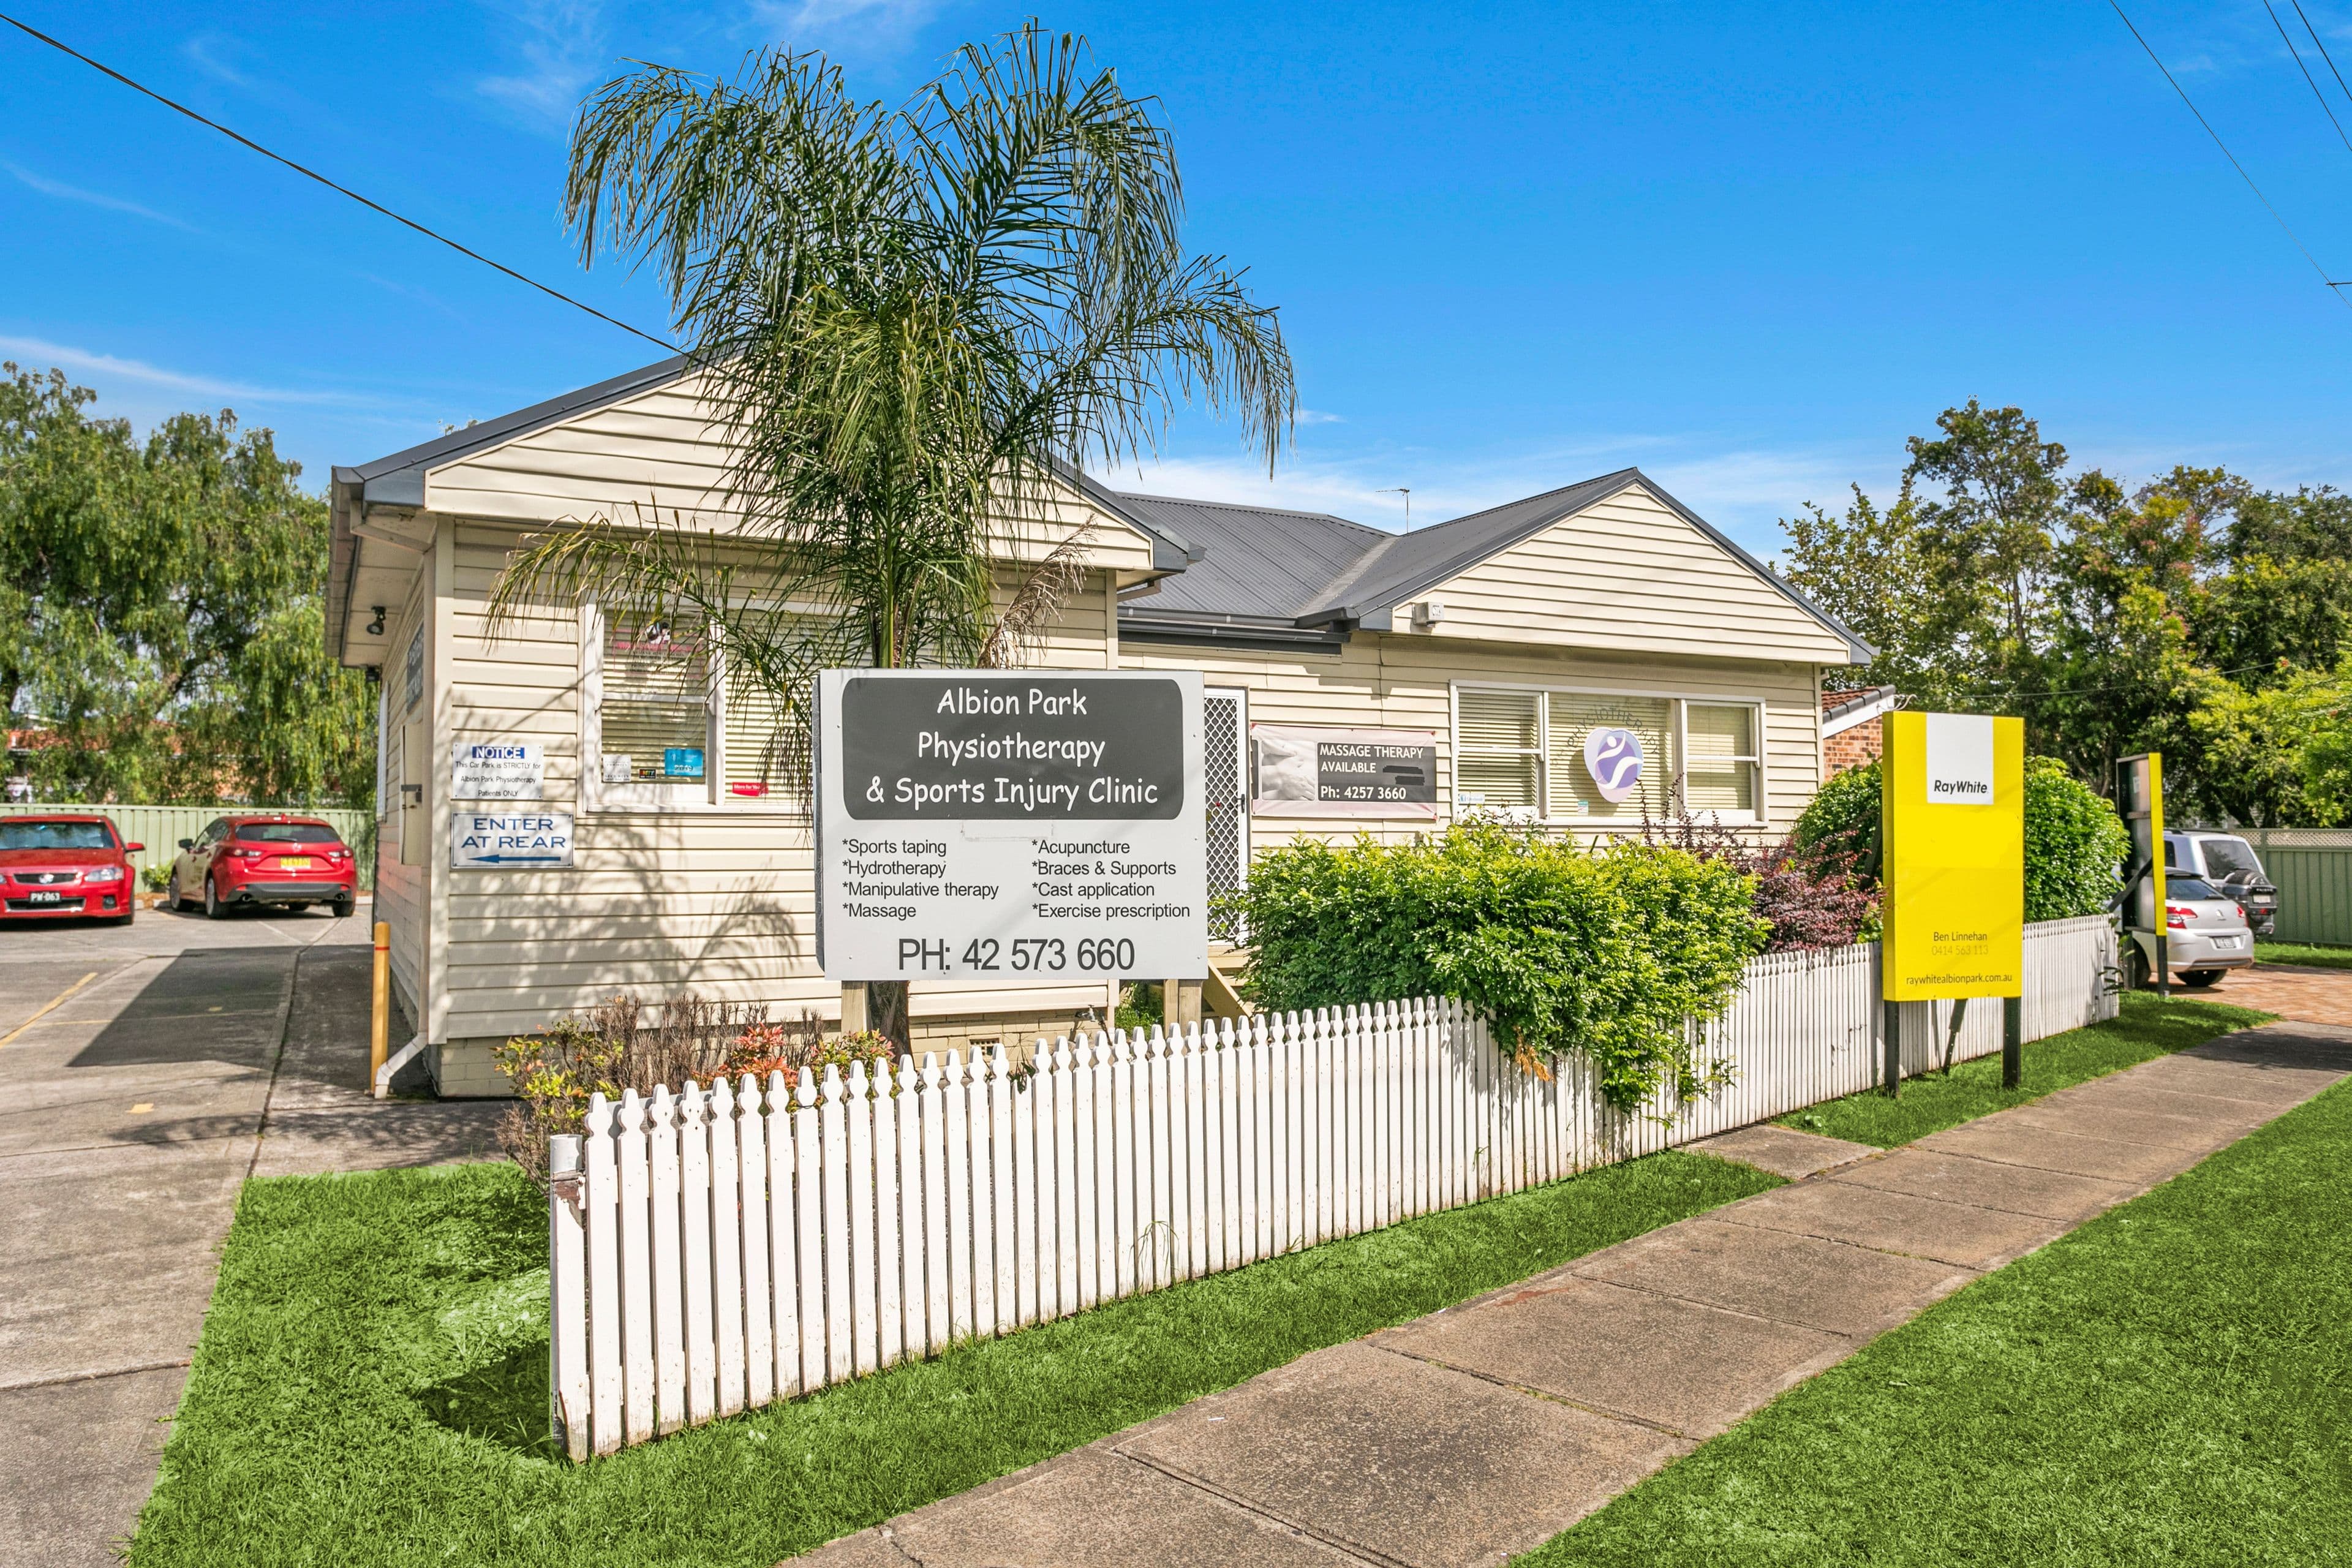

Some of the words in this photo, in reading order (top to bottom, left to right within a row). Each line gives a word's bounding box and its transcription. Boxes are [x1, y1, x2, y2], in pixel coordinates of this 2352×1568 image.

[937, 687, 1020, 715] Albion
[1029, 687, 1087, 715] Park
[476, 747, 521, 759] NOTICE
[918, 731, 1106, 767] Physiotherapy
[1319, 744, 1371, 757] MASSAGE
[1374, 745, 1424, 759] THERAPY
[1321, 761, 1376, 774] AVAILABLE
[496, 776, 537, 785] Physiotherapy
[866, 775, 884, 803] &
[894, 777, 985, 811] Sports
[994, 777, 1079, 812] Injury
[1088, 777, 1158, 804] Clinic
[1321, 785, 1340, 799] Ph:
[1344, 786, 1374, 800] 4257
[1378, 786, 1407, 801] 3660
[473, 818, 554, 831] ENTER
[461, 835, 491, 849] AT
[498, 835, 567, 849] REAR
[902, 839, 947, 858] taping
[1095, 861, 1106, 876] &
[1110, 861, 1177, 878] Supports
[944, 881, 1000, 900] therapy
[1078, 881, 1155, 900] application
[1106, 903, 1191, 921] prescription
[1933, 932, 1949, 941] Ben
[1951, 932, 1988, 941] Linnehan
[899, 938, 951, 971] PH:
[962, 938, 1000, 971] 42
[1011, 938, 1066, 971] 573
[1077, 938, 1135, 971] 660
[1906, 973, 2012, 986] raywhitealbionpark.com.au
